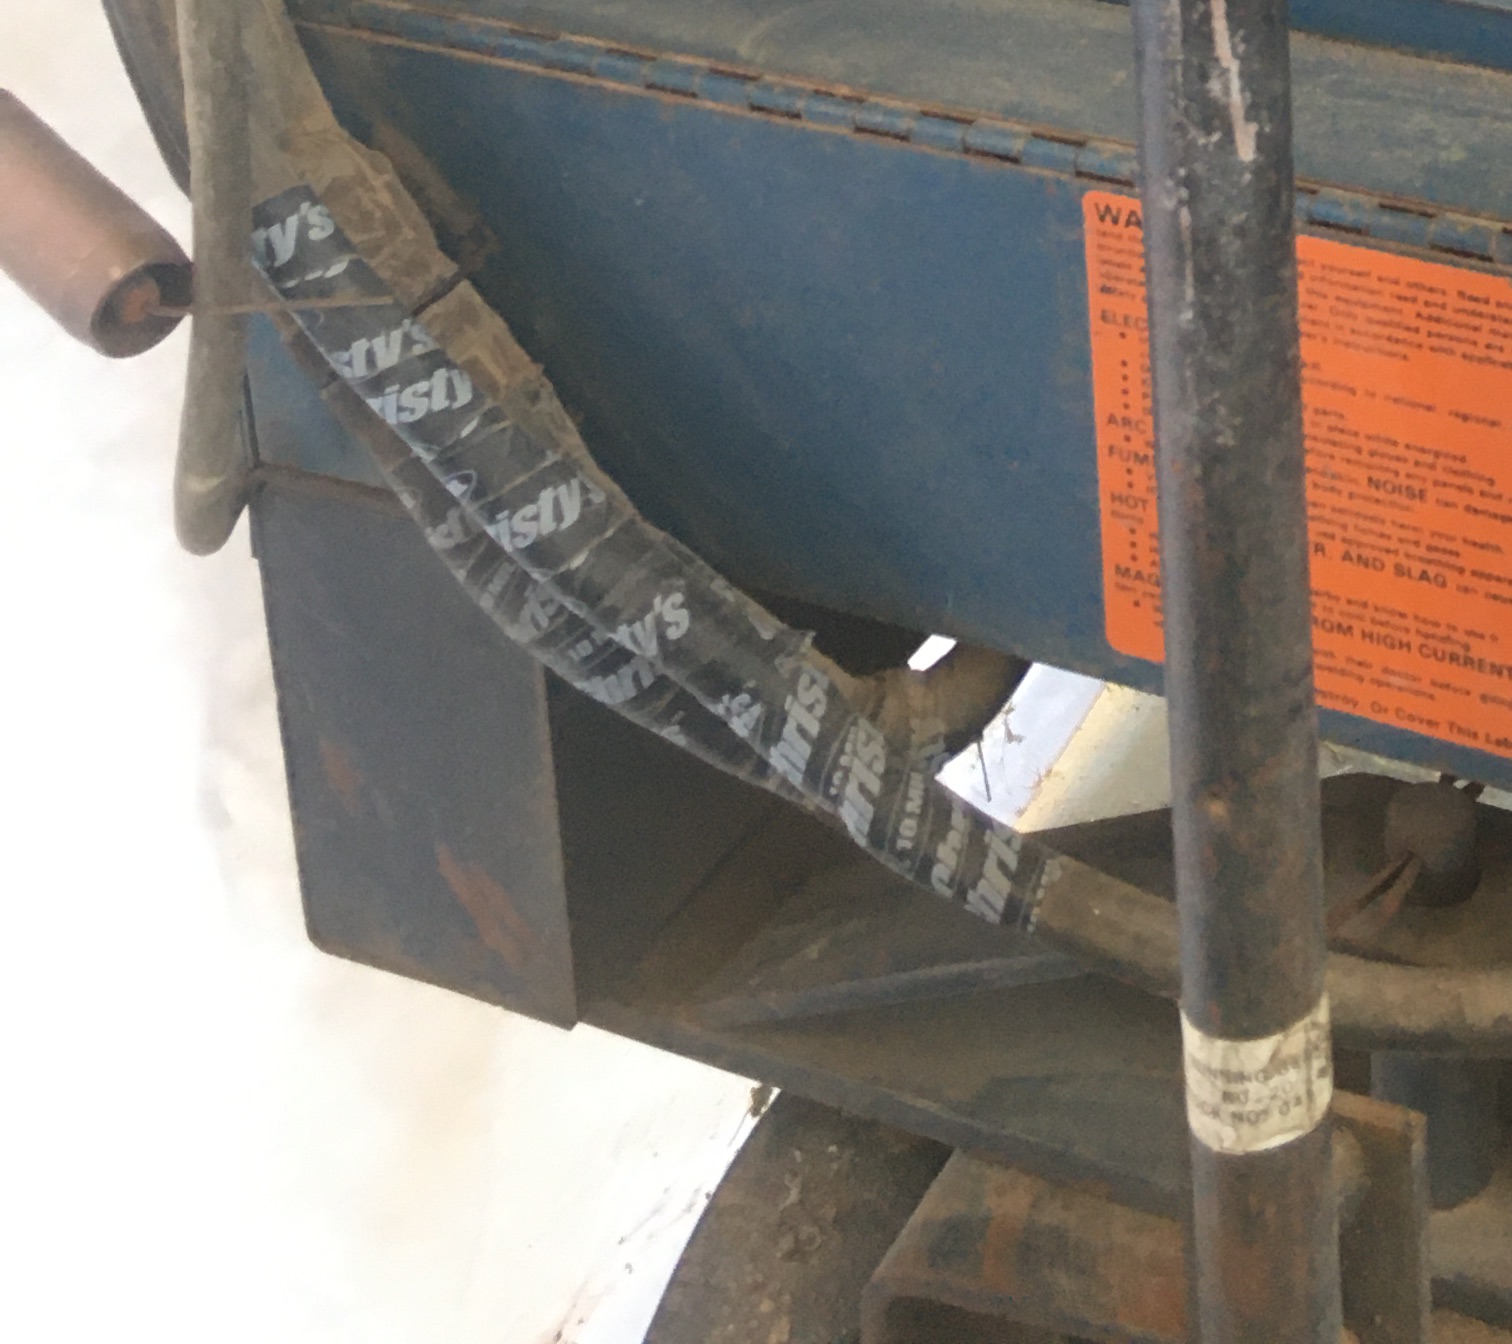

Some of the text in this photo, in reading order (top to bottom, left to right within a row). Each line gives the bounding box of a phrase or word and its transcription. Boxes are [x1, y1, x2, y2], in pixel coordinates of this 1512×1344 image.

[1366, 474, 1428, 504] NOISE
[1340, 548, 1385, 574] AND
[1360, 628, 1412, 655] HIGH
